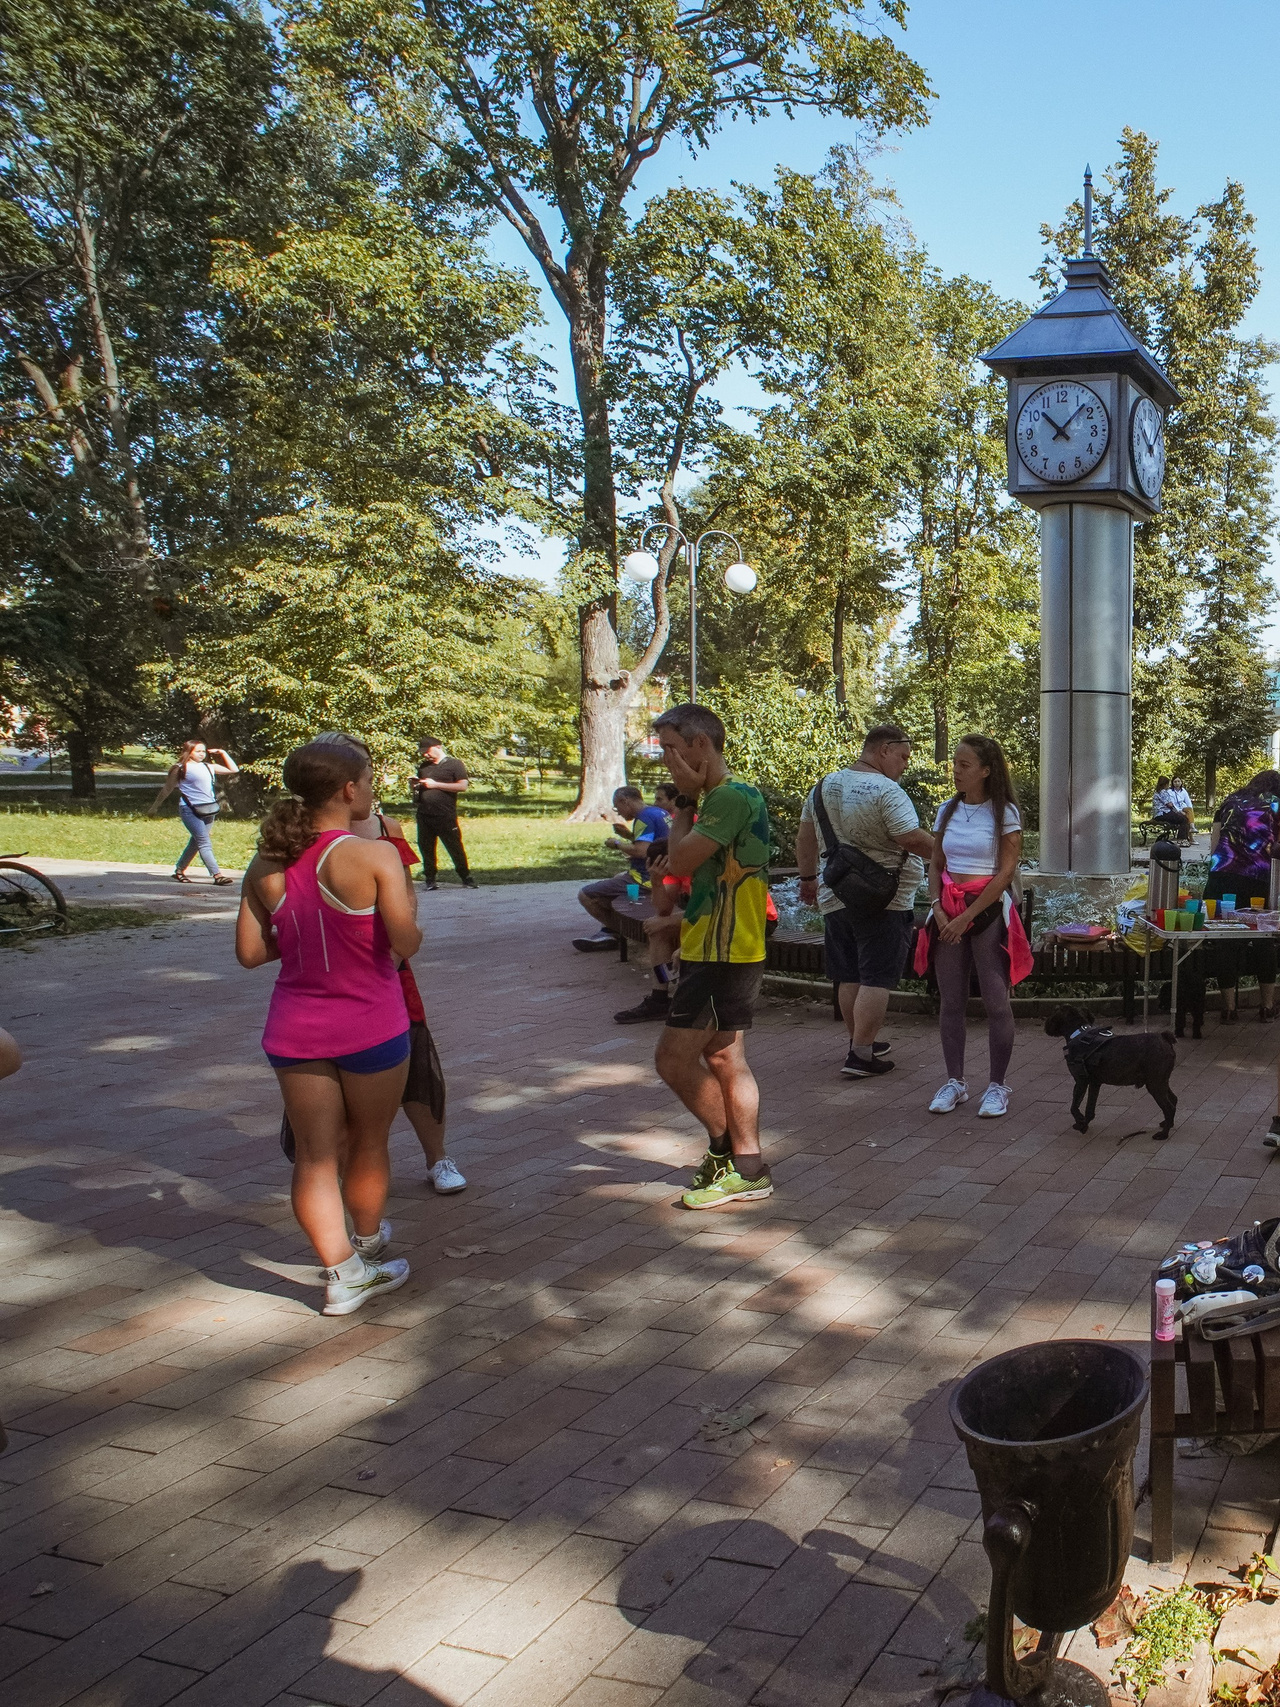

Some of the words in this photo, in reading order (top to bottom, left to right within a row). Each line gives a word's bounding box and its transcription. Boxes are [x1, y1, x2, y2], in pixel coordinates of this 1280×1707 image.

[1042, 396, 1051, 409] 11
[1056, 390, 1068, 403] 12
[1075, 394, 1080, 407] 1
[1028, 409, 1040, 422] 10
[1086, 406, 1094, 419] 2
[1026, 427, 1034, 440] 9
[1090, 424, 1098, 437] 3
[1030, 444, 1038, 457] 8
[1086, 442, 1093, 455] 4
[1042, 457, 1050, 470] 7
[1058, 461, 1066, 474] 6
[1074, 456, 1082, 468] 5
